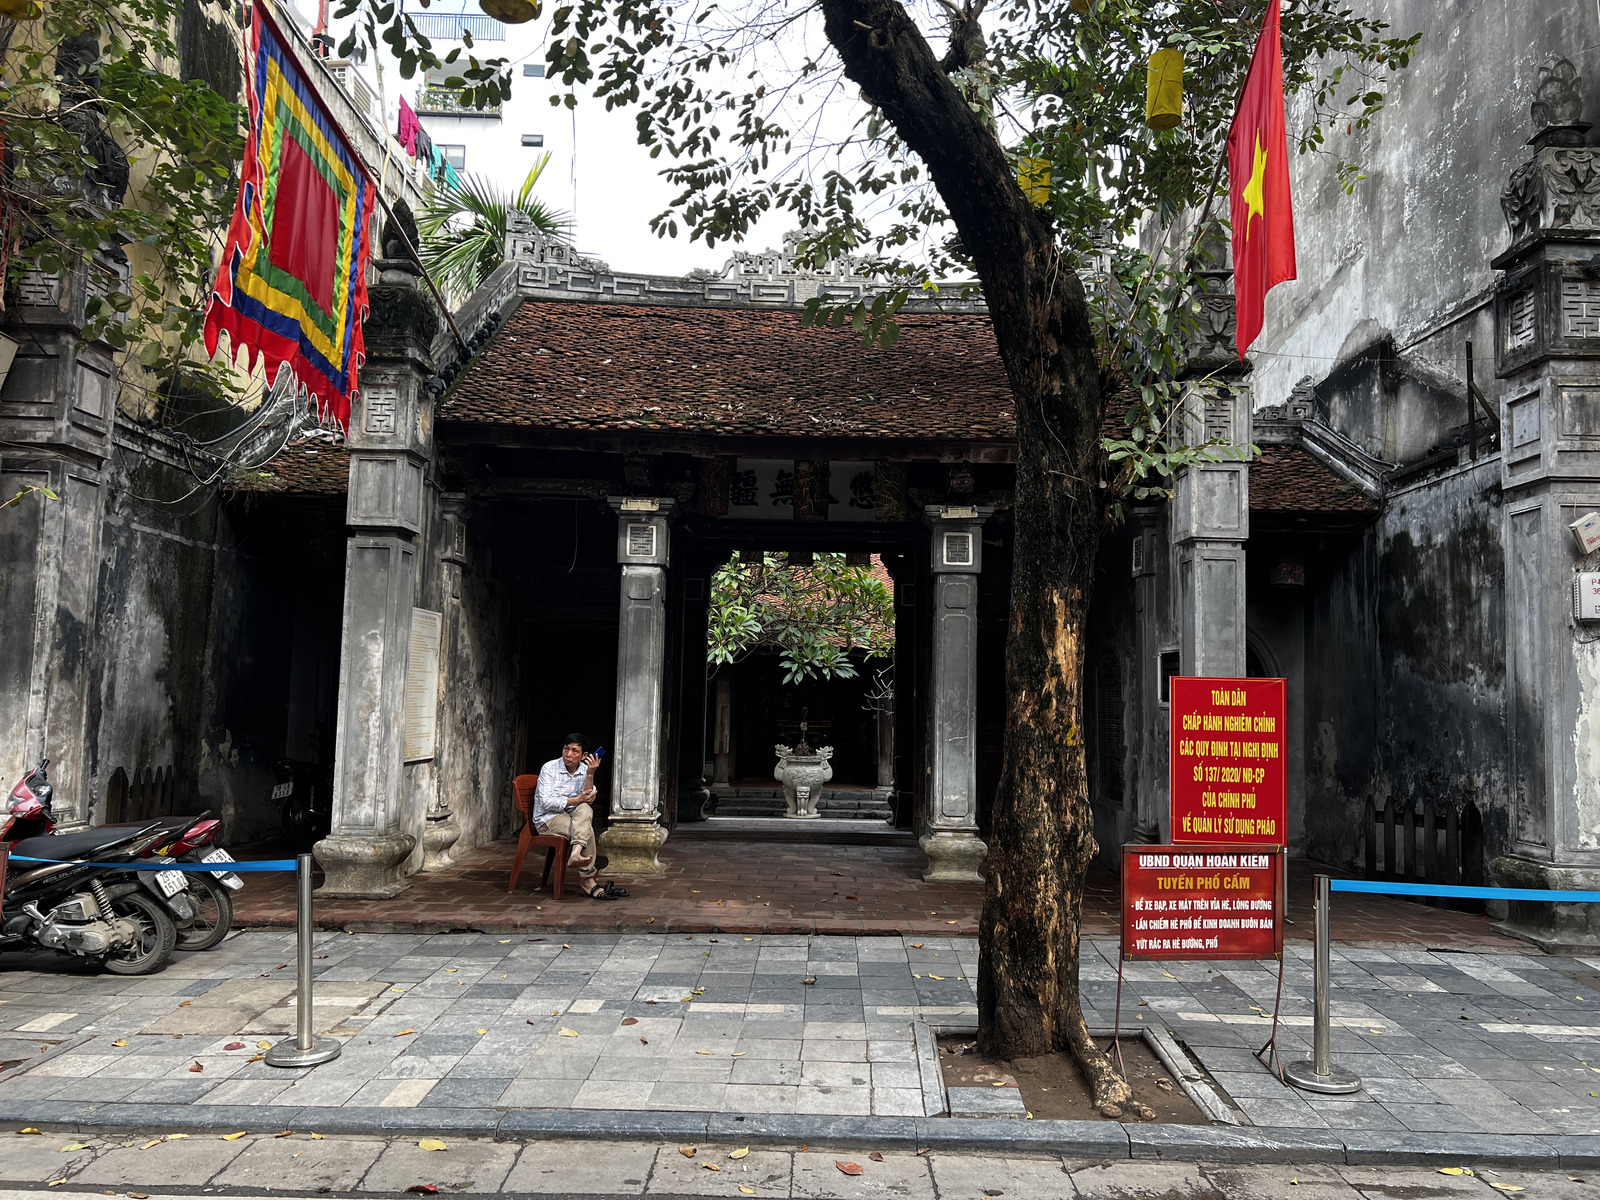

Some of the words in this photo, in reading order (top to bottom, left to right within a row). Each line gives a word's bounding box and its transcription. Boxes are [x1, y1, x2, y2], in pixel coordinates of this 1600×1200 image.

[1211, 687, 1230, 706] TOÀN
[1232, 688, 1246, 706] DÂN
[1182, 710, 1202, 730] CHẤP
[1203, 712, 1222, 731] HÀNH
[1224, 713, 1252, 732] NGHIÊM
[1254, 711, 1276, 732] CHỈNH
[1180, 737, 1194, 756] CÁC
[1196, 741, 1210, 758] QUY
[1211, 741, 1228, 760] ĐỊNH
[1230, 742, 1241, 760] TẠI
[1243, 742, 1260, 761] NGHỊ
[1261, 742, 1278, 762] ĐỊNH
[1193, 761, 1203, 782] SỐ
[1243, 768, 1265, 784] NĐ-CP
[1202, 785, 1216, 808] CỦA
[1218, 789, 1240, 808] CHÍNH
[1242, 787, 1256, 809] PHỦ
[1182, 811, 1191, 832] VỀ
[1193, 811, 1212, 834] QUẢN
[1214, 815, 1222, 833] LÝ
[1224, 812, 1234, 834] SỬ
[1235, 818, 1254, 837] DỤNG
[1256, 816, 1275, 835] PHÁO
[1139, 855, 1170, 867] UBND
[1173, 854, 1203, 869] QUẬN
[1206, 853, 1237, 867] HOÀN
[1157, 873, 1193, 890] TUYẾN
[1197, 873, 1220, 890] PHỐ
[1224, 873, 1250, 890] CẤM
[1145, 900, 1153, 910] XE
[1154, 900, 1168, 912] ĐẠP,
[1169, 900, 1177, 910] XE
[1178, 898, 1192, 910] MÁY
[1193, 898, 1209, 910] TRÊN
[1210, 897, 1220, 910] VỈA
[1222, 898, 1231, 911] HÈ,
[1233, 898, 1249, 910] LÒNG
[1250, 898, 1272, 910] ĐƯỜNG
[1149, 916, 1169, 929] CHIẾM
[1170, 918, 1178, 929] HÈ
[1180, 916, 1192, 929] PHỐ
[1193, 915, 1202, 929] ĐỂ
[1203, 919, 1218, 929] KINH
[1219, 919, 1240, 929] DOANH
[1241, 917, 1258, 929] BUÔN
[1260, 917, 1272, 929] BÁN
[1136, 937, 1148, 949] VỨT
[1149, 937, 1161, 949] RÁC
[1163, 940, 1171, 949] RA
[1172, 937, 1180, 949] HÈ
[1206, 935, 1218, 949] PHỐ
